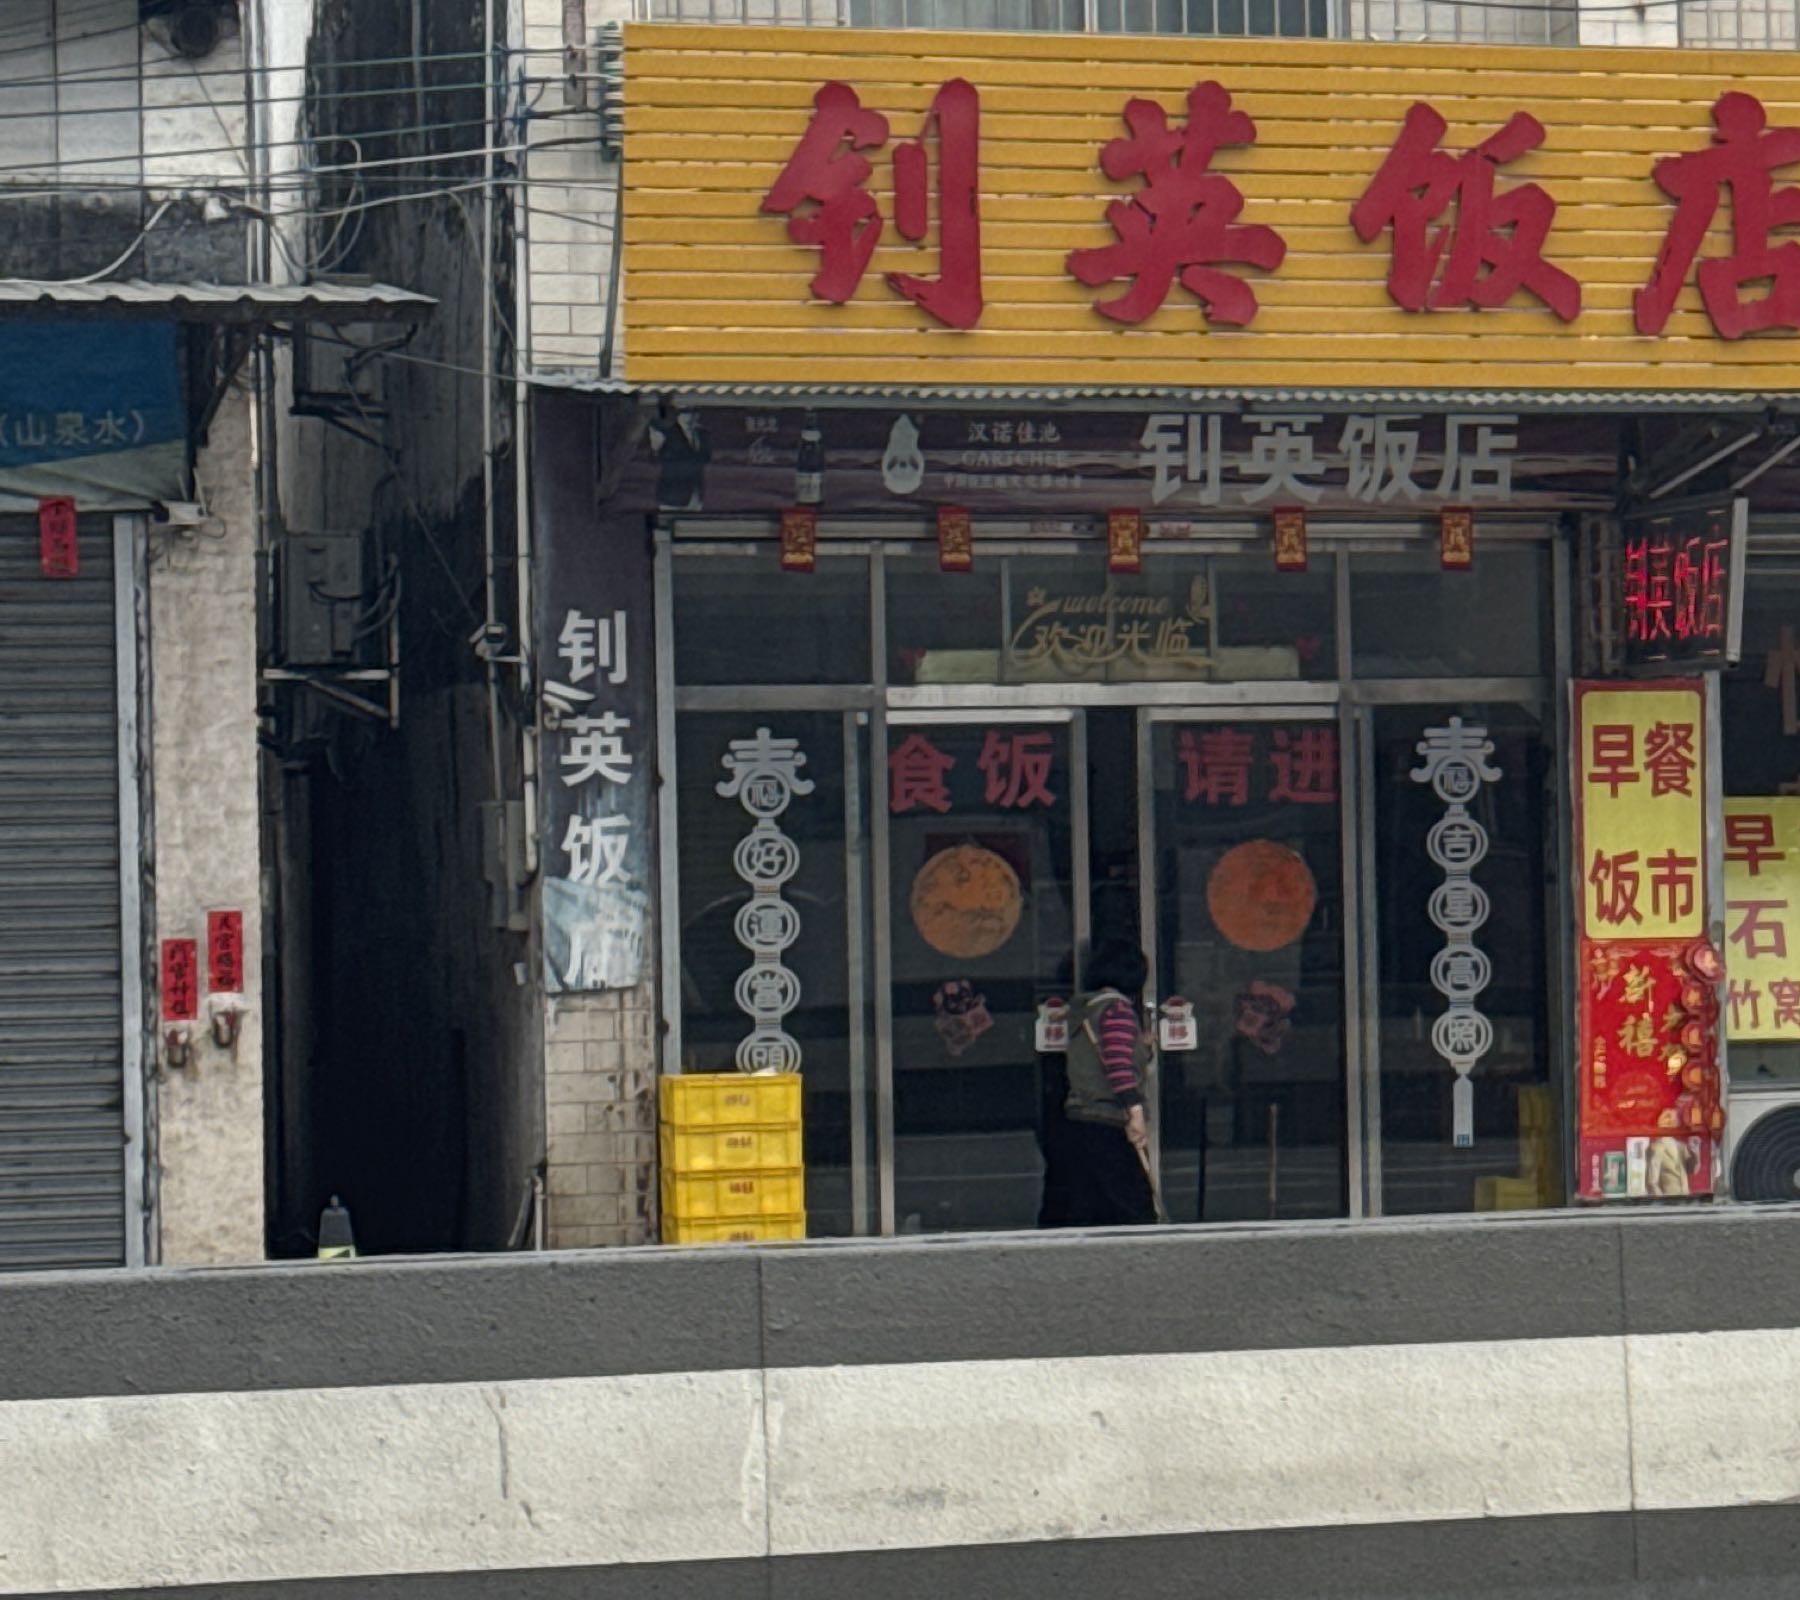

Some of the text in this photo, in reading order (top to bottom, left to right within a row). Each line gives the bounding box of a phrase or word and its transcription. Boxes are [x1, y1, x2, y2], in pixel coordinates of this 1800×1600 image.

[1138, 414, 1519, 505] 钊英饭店
[1029, 618, 1195, 662] 欢迎光临
[1062, 593, 1169, 614] welcome
[887, 727, 1339, 813] 食饭 请进
[1588, 720, 1697, 799] 早餐
[1588, 847, 1699, 927] 饭市
